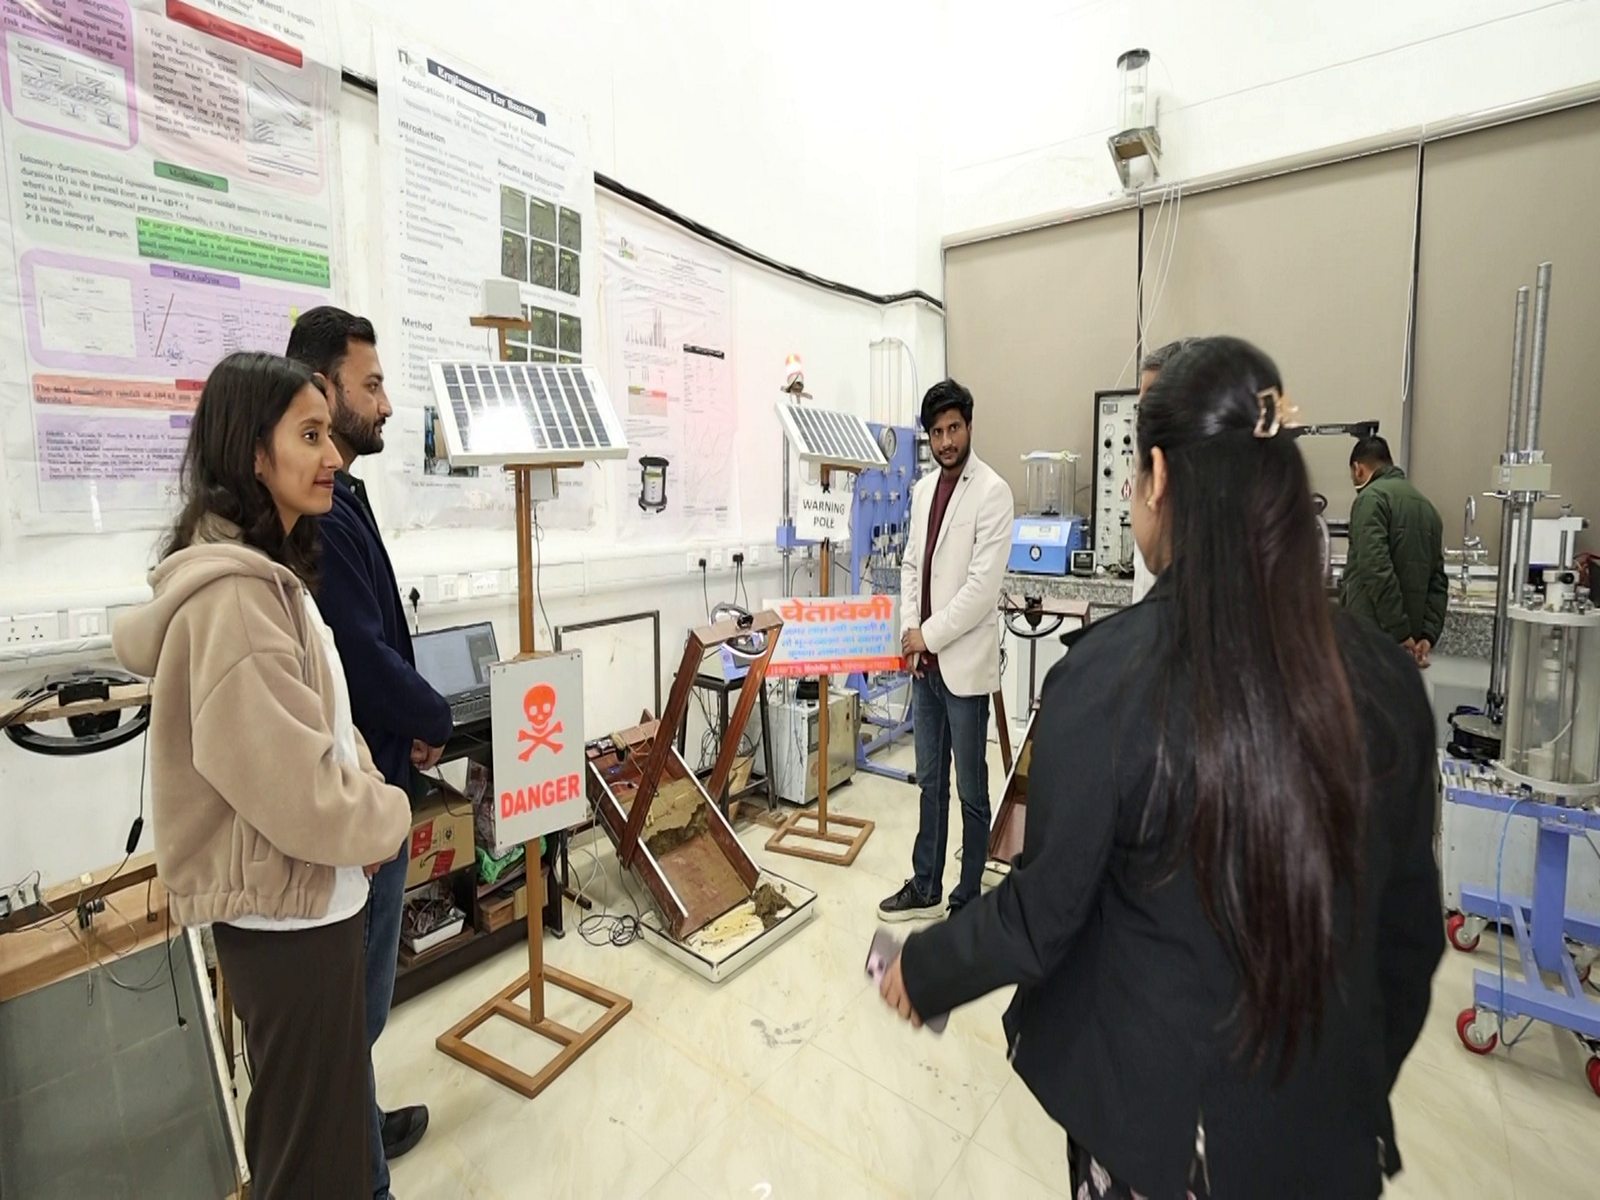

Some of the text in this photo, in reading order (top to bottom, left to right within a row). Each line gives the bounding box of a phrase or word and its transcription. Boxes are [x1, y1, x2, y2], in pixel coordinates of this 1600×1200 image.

[402, 75, 445, 101] Application
[493, 93, 506, 108] for
[398, 118, 446, 145] Introduction
[522, 169, 533, 181] and
[174, 271, 221, 287] Data Analysis
[401, 316, 433, 332] Method
[803, 499, 845, 515] WARNING
[814, 516, 835, 529] POLE
[780, 594, 892, 622] चेतावनी
[804, 662, 829, 673] Mobile
[500, 773, 581, 820] DANGER
